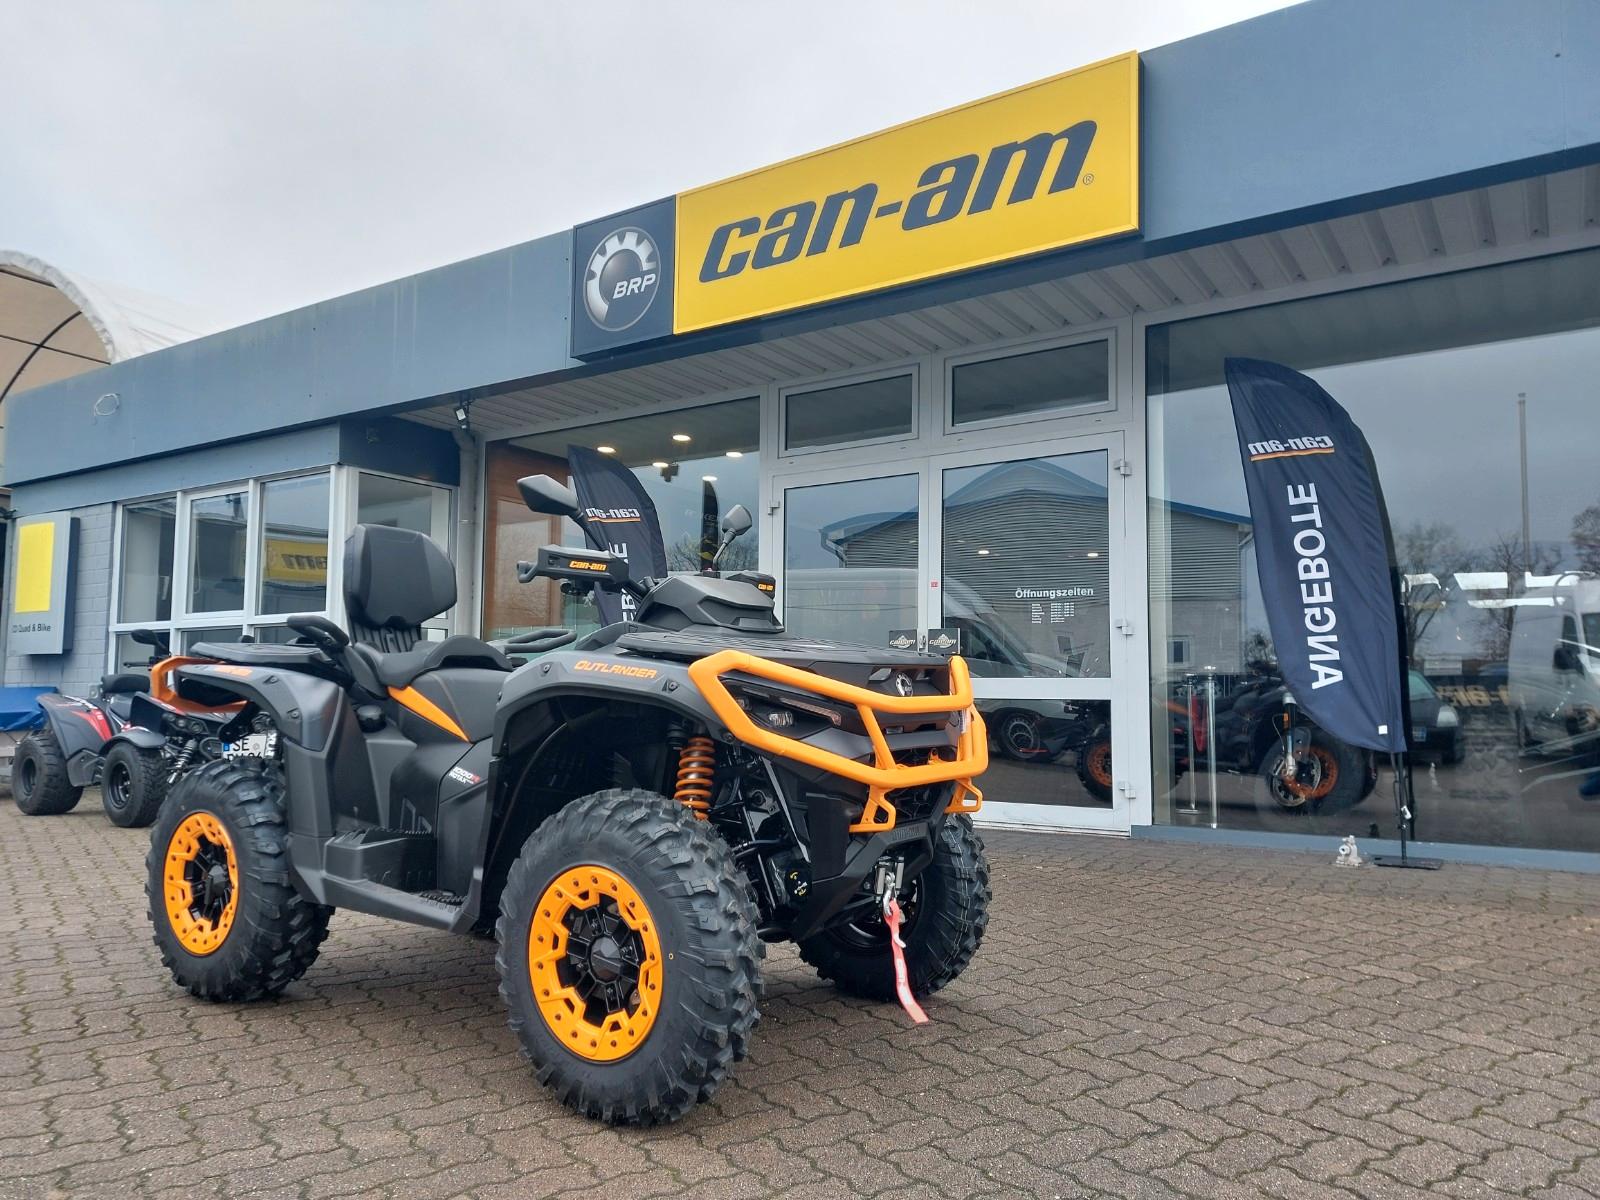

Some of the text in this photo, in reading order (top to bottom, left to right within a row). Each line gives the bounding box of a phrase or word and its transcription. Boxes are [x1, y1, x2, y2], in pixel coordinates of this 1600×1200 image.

[612, 273, 656, 299] BRP
[1015, 587, 1094, 599] Öffnungszeiten
[574, 660, 658, 679] OUTLANDER
